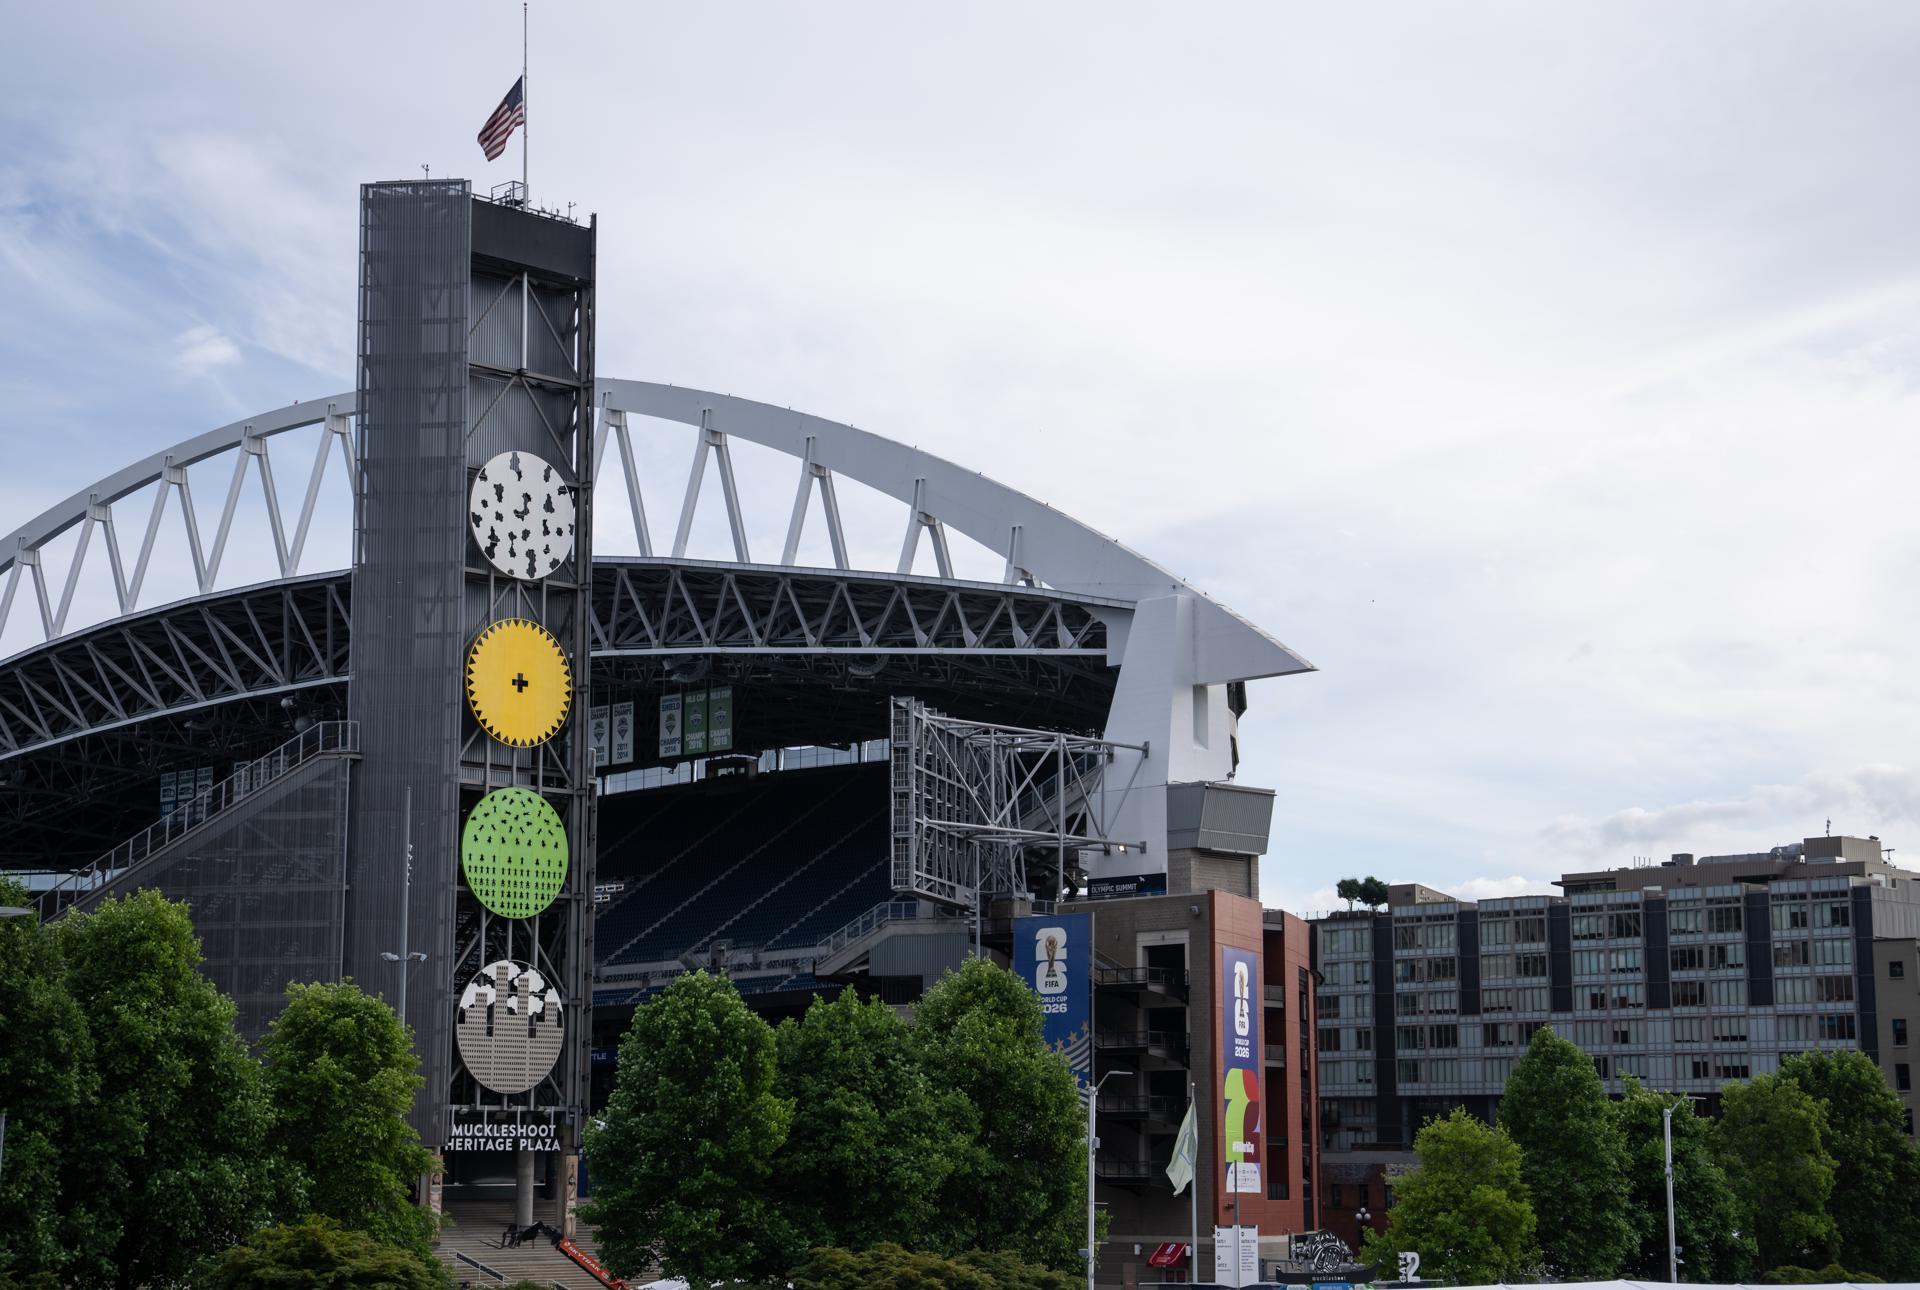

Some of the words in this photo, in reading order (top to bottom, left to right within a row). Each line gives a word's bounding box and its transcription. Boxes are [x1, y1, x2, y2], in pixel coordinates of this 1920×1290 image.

[1091, 885, 1114, 893] OLYMPIC
[1115, 883, 1137, 891] SUMMIT
[1040, 1003, 1067, 1014] 026
[1235, 1046, 1250, 1058] 2026
[452, 1124, 556, 1137] MUCKLESHOOT
[445, 1138, 513, 1151] HERITAGE
[520, 1138, 560, 1151] PLAZA
[1398, 1252, 1406, 1283] GATE
[1406, 1252, 1420, 1282] 2
